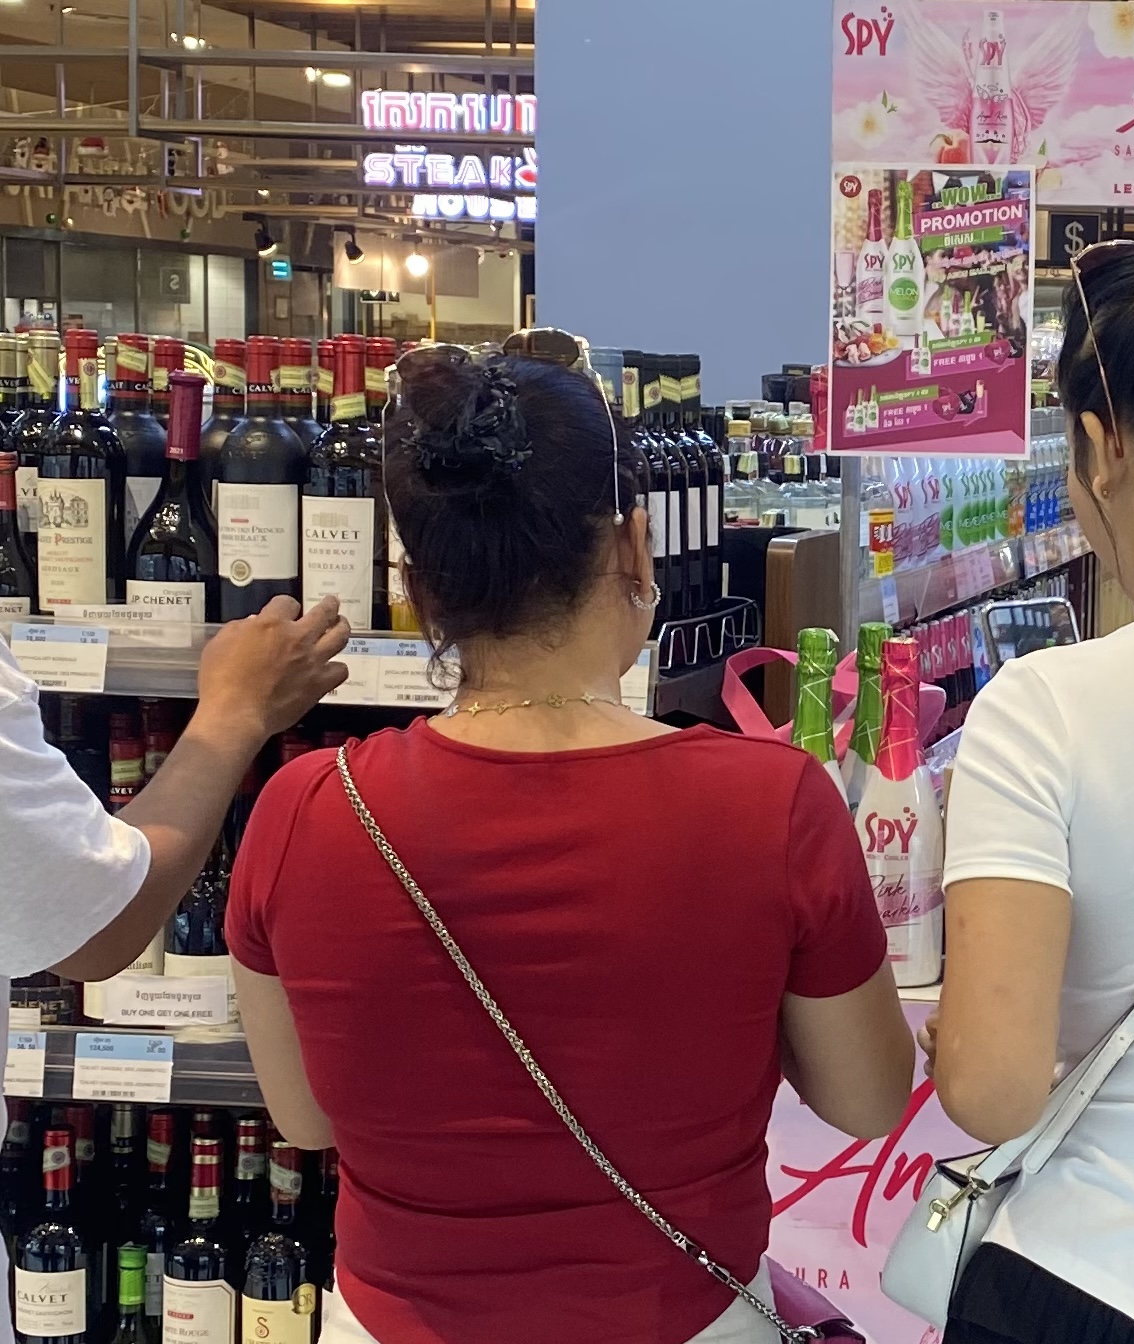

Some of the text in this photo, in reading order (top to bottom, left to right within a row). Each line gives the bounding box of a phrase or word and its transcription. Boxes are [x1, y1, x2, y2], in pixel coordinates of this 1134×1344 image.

[841, 6, 895, 56] SPY
[363, 153, 512, 188] STEAK
[920, 204, 1023, 233] PROMOTION
[864, 251, 886, 271] SPY
[892, 252, 916, 272] SPY
[933, 357, 956, 367] FREE
[249, 384, 275, 393] CALV
[883, 407, 904, 417] FREE
[305, 528, 361, 540] CALVET
[143, 595, 192, 605] CHENET
[864, 807, 918, 854] SPY
[174, 1010, 190, 1018] ONE
[17, 1290, 68, 1304] CALVET
